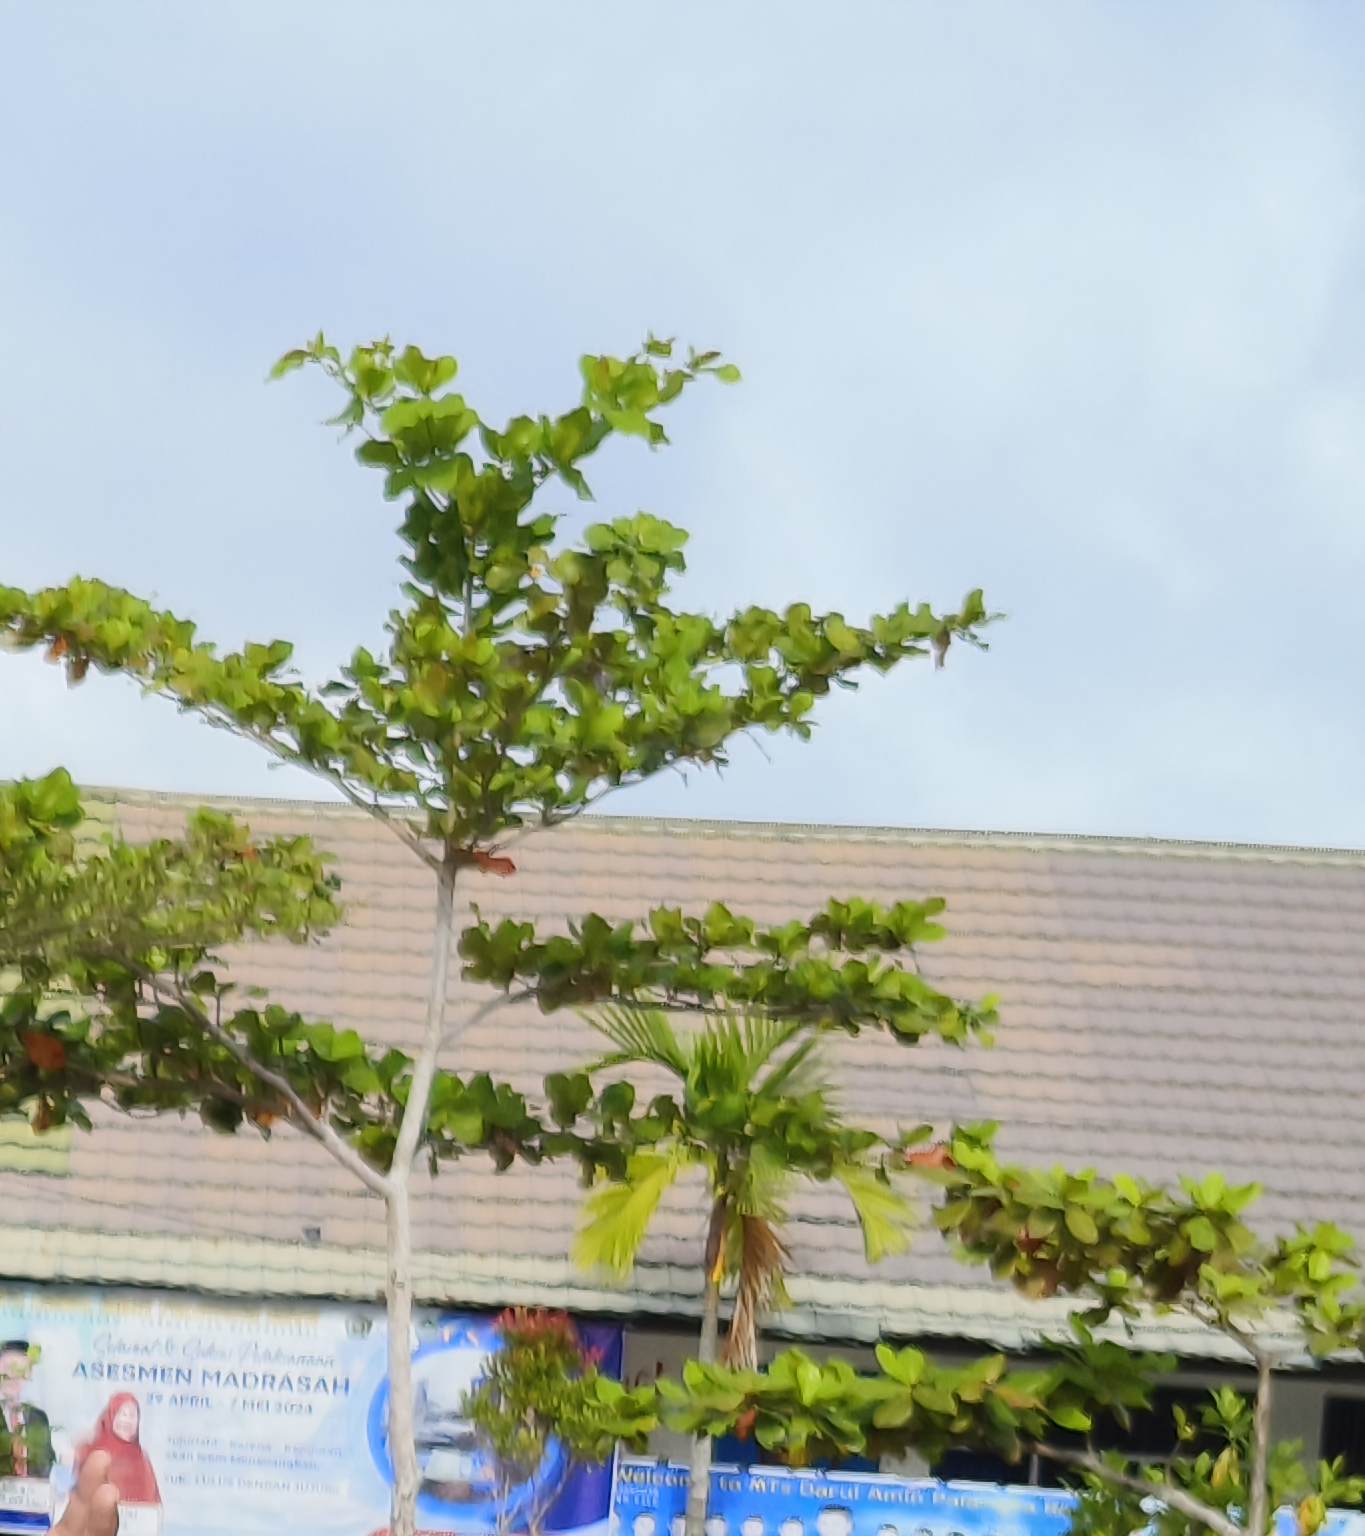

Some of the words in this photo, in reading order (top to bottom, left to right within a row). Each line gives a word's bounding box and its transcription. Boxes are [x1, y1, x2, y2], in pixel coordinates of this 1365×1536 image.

[72, 1360, 193, 1388] ASESMEN
[200, 1367, 350, 1398] MADRASAH
[168, 1394, 212, 1409] APRIL
